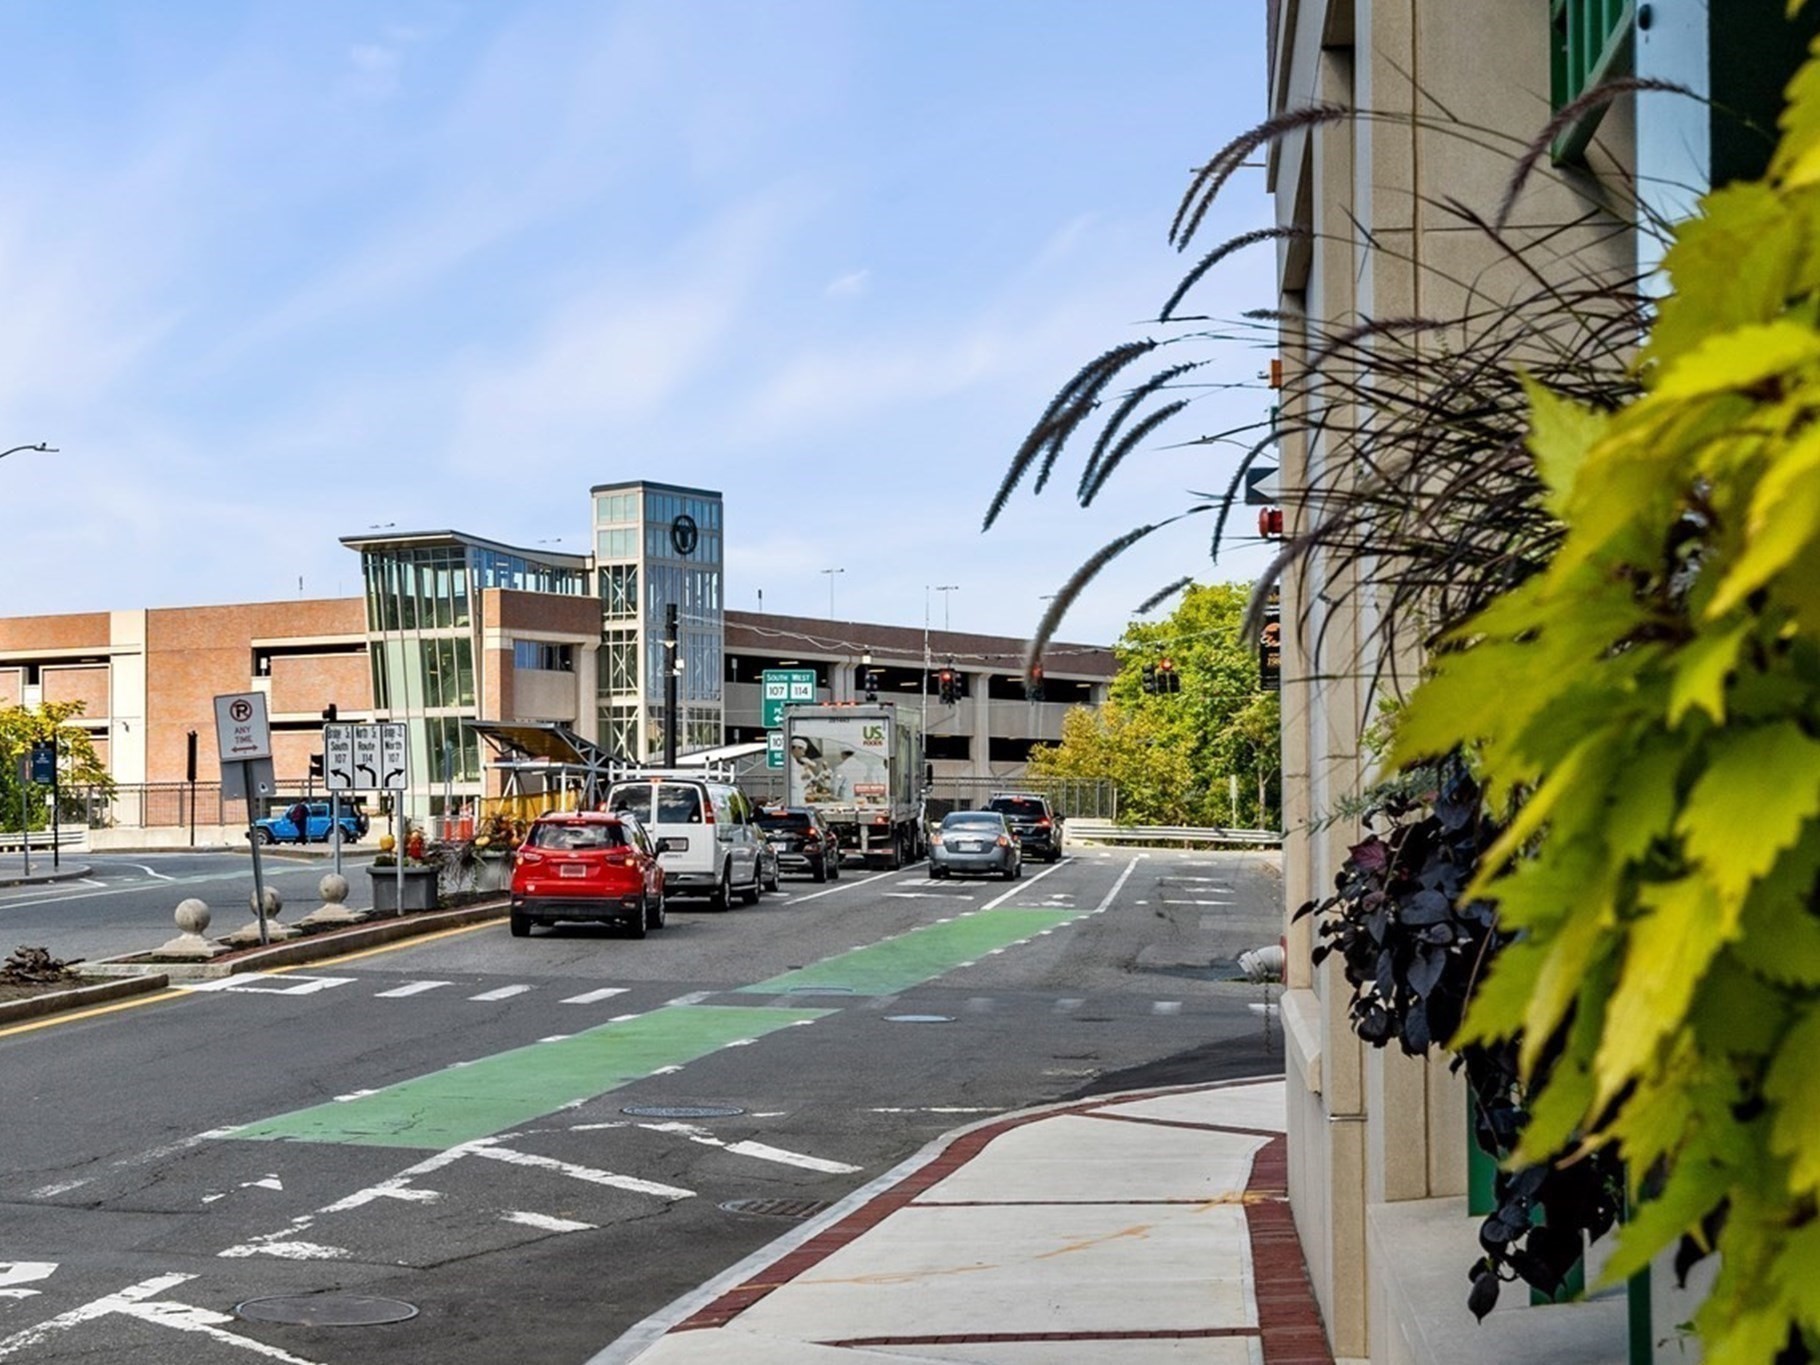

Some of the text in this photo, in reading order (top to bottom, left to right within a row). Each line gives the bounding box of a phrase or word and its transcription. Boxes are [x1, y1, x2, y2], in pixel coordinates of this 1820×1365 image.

[766, 673, 810, 682] SOUTH WEST
[768, 686, 809, 696] 107 114
[234, 725, 251, 735] ANY
[234, 735, 253, 744] TIME
[330, 741, 349, 751] South
[358, 741, 375, 751] Route
[385, 741, 402, 750] North
[334, 753, 347, 763] 107
[362, 753, 373, 763] 114
[388, 753, 400, 763] 107
